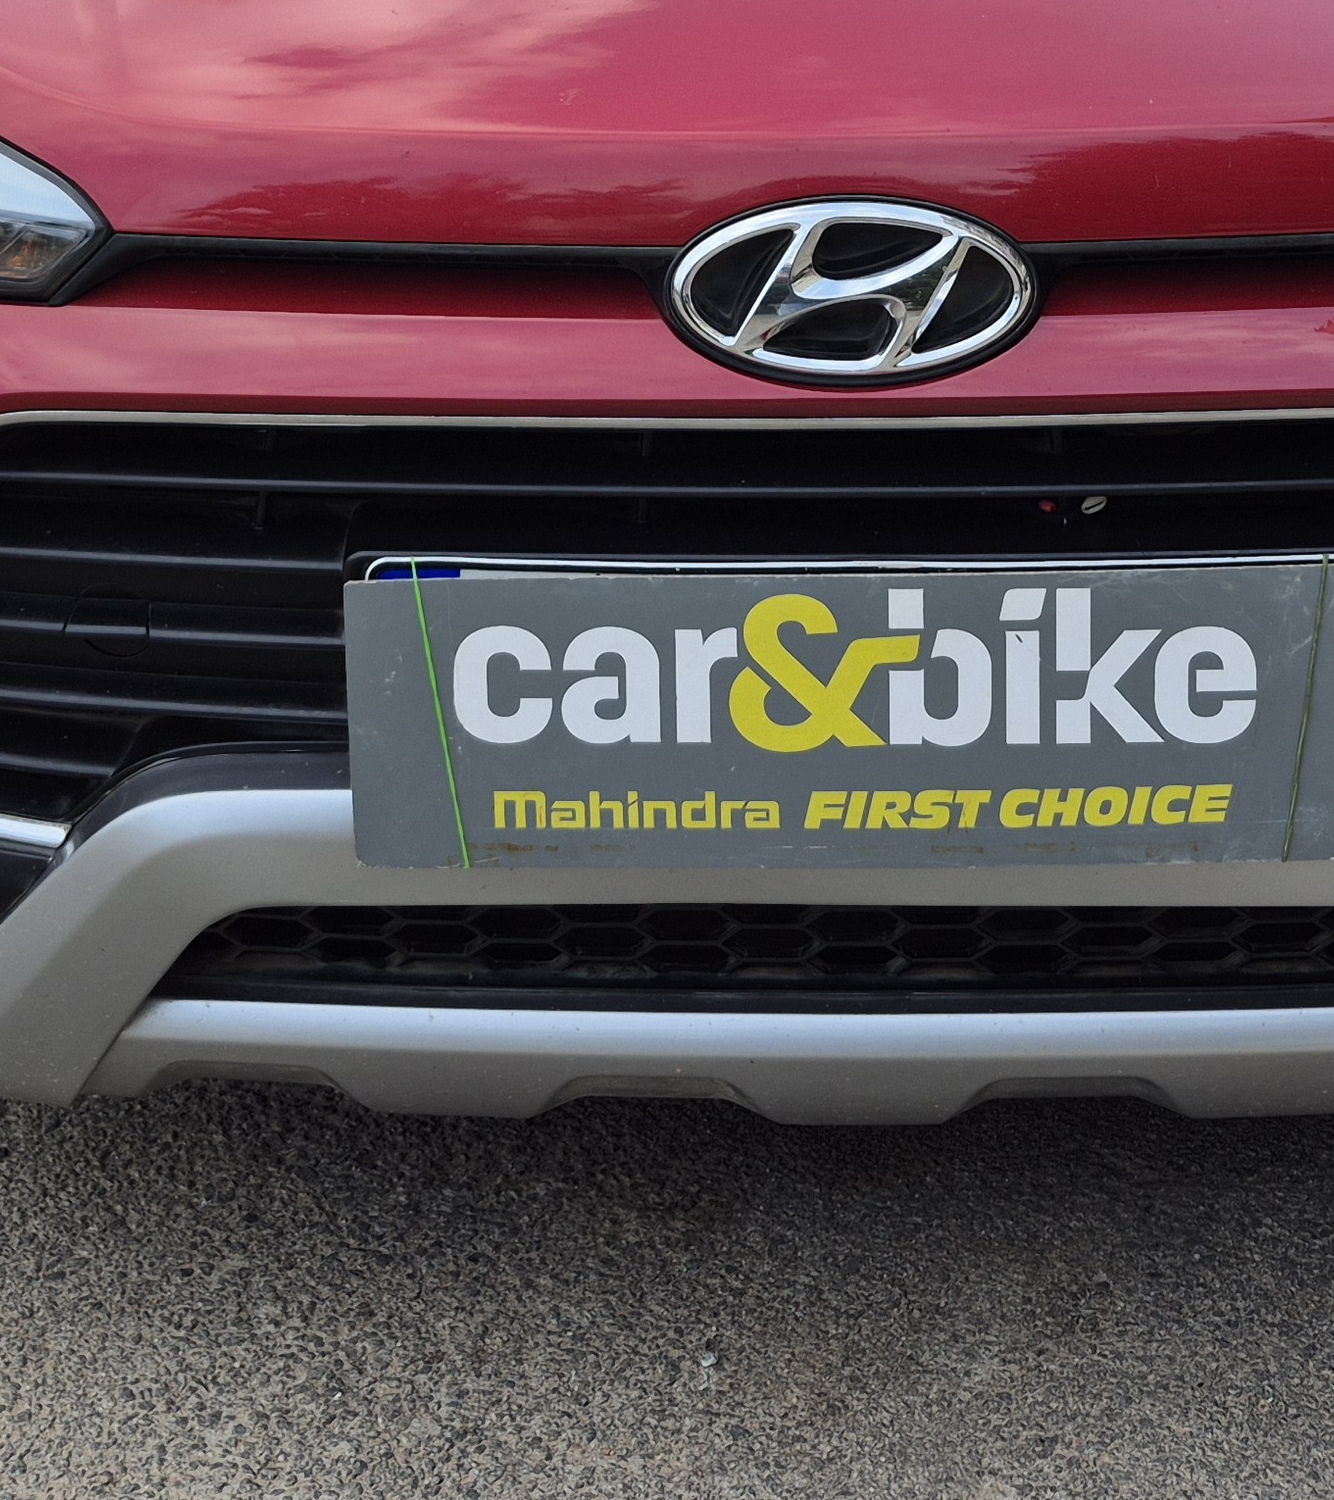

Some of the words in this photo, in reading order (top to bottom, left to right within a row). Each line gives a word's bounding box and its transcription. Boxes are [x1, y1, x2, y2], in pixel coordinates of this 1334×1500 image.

[453, 587, 1257, 753] car&bike
[494, 790, 780, 829] Mahindra
[803, 789, 992, 829] FIRST
[999, 784, 1233, 827] CHOICE
